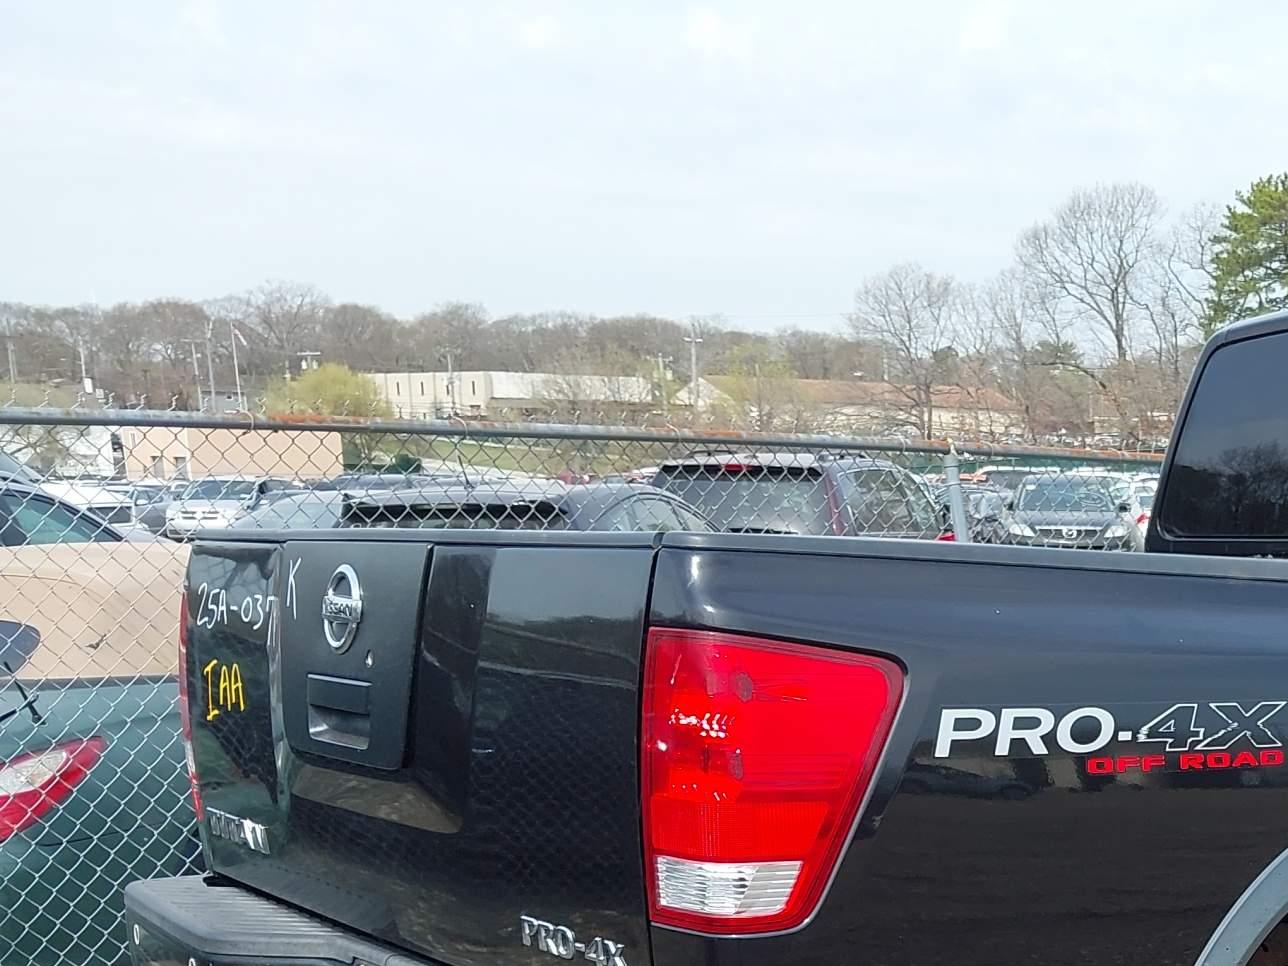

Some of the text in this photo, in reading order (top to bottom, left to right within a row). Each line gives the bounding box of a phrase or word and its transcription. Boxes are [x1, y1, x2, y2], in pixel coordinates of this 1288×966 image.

[203, 659, 246, 720] IAA
[934, 701, 1288, 758] PRO-4X
[1086, 750, 1285, 775] OFF ROAD
